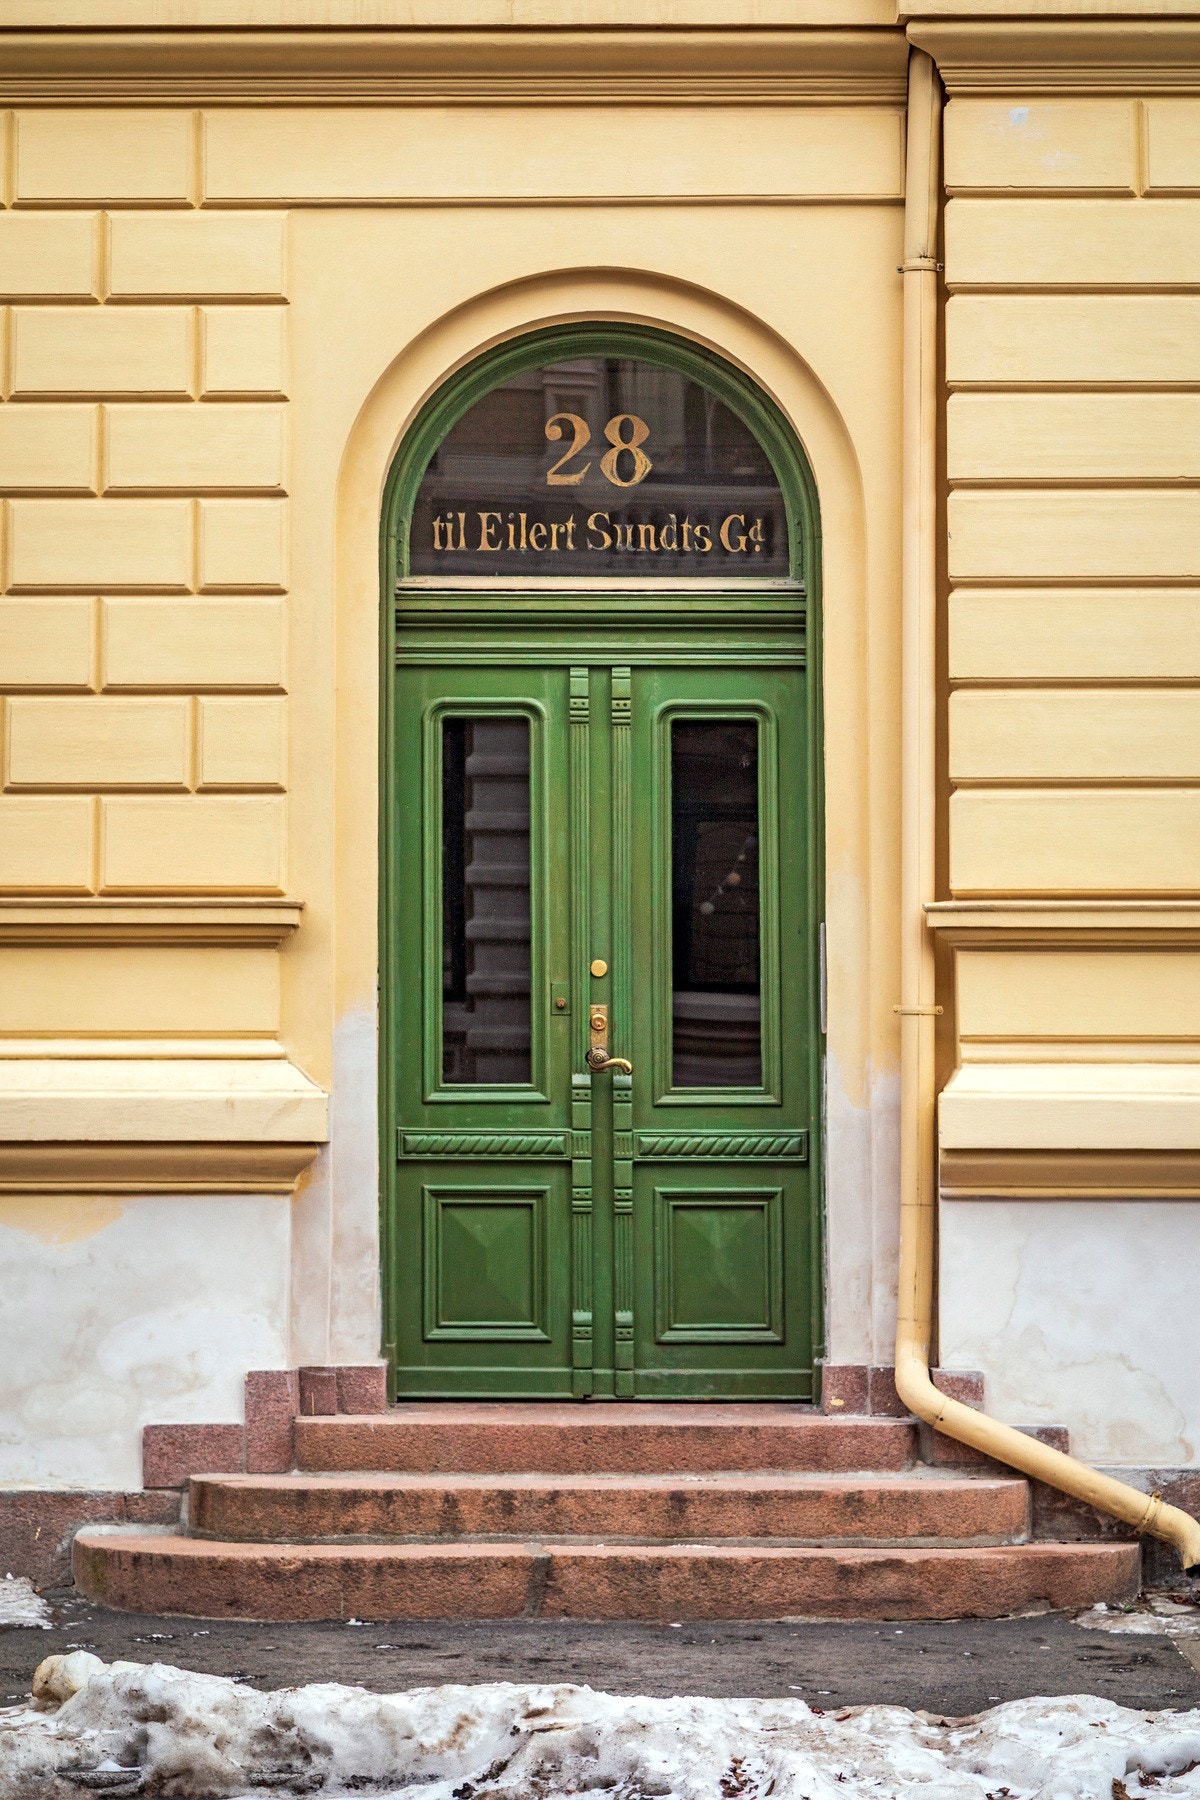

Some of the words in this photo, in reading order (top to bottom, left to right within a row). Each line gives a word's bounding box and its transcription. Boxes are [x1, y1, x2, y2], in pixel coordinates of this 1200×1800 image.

[544, 412, 653, 487] 28
[432, 512, 467, 551] til
[475, 512, 578, 552] Eilert
[586, 511, 712, 552] Sundts
